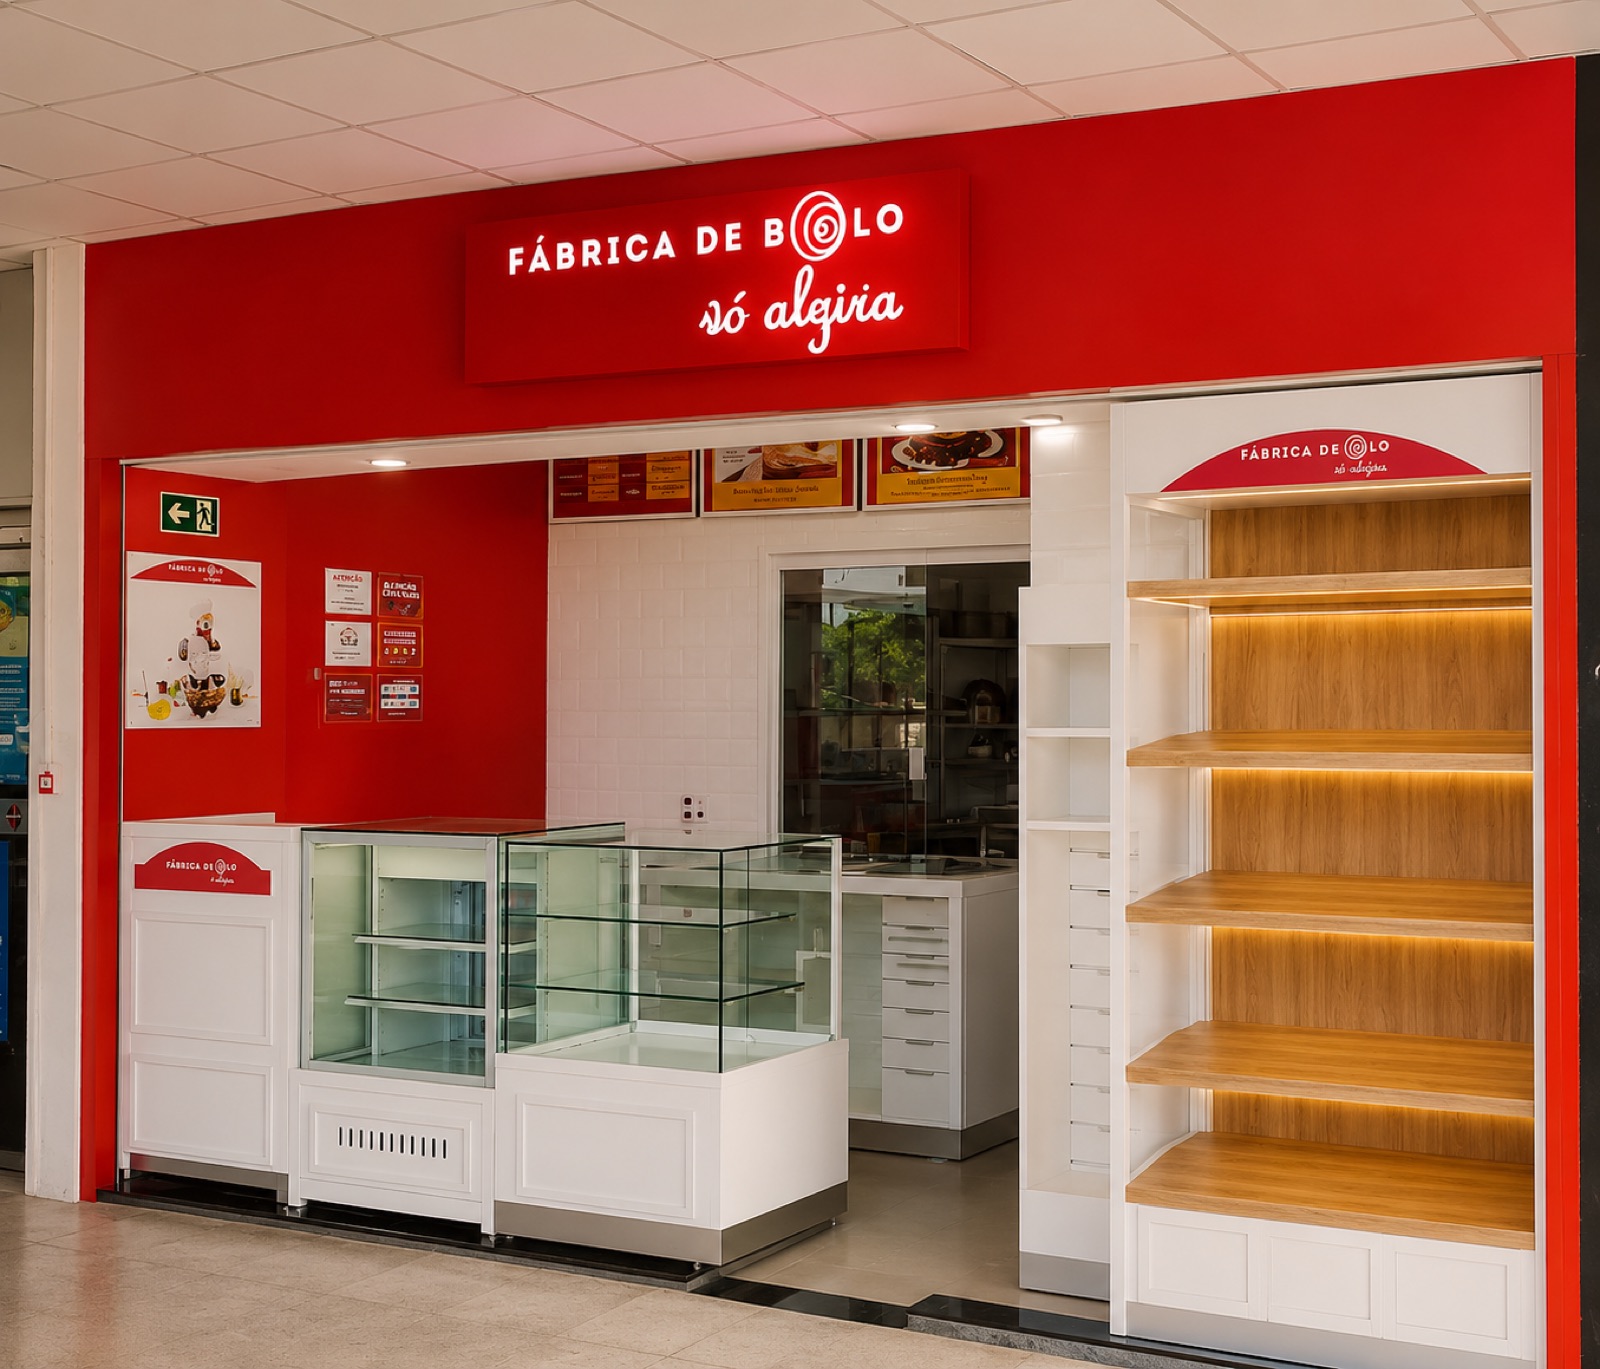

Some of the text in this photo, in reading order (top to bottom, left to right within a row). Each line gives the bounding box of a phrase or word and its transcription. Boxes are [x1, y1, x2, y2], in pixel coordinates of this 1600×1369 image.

[508, 189, 904, 276] FÁBRICA DE BOLO
[1240, 444, 1313, 461] FÁBRICA
[1319, 443, 1340, 456] DE
